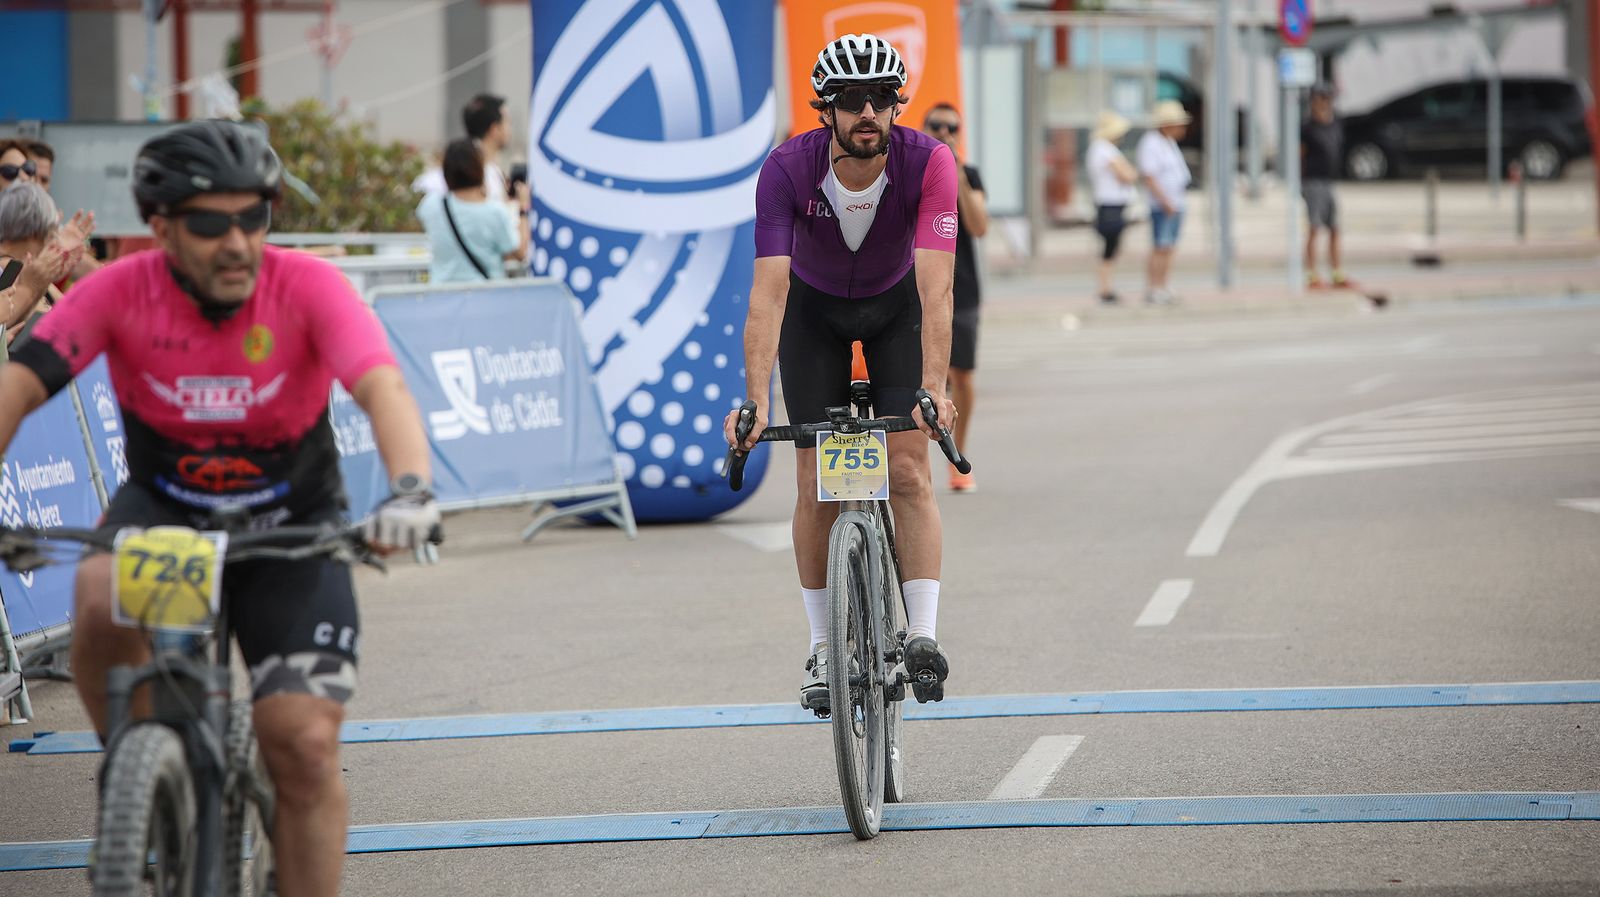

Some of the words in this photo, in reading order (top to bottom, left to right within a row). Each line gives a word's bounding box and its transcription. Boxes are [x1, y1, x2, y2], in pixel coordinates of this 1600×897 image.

[474, 342, 565, 389] Diputación
[490, 396, 516, 433] de
[513, 391, 563, 430] Cádiz
[15, 454, 75, 501] Ayuntamiento
[825, 449, 880, 470] 755
[26, 500, 41, 530] de
[36, 498, 63, 530] Jerez
[127, 548, 207, 588] 726
